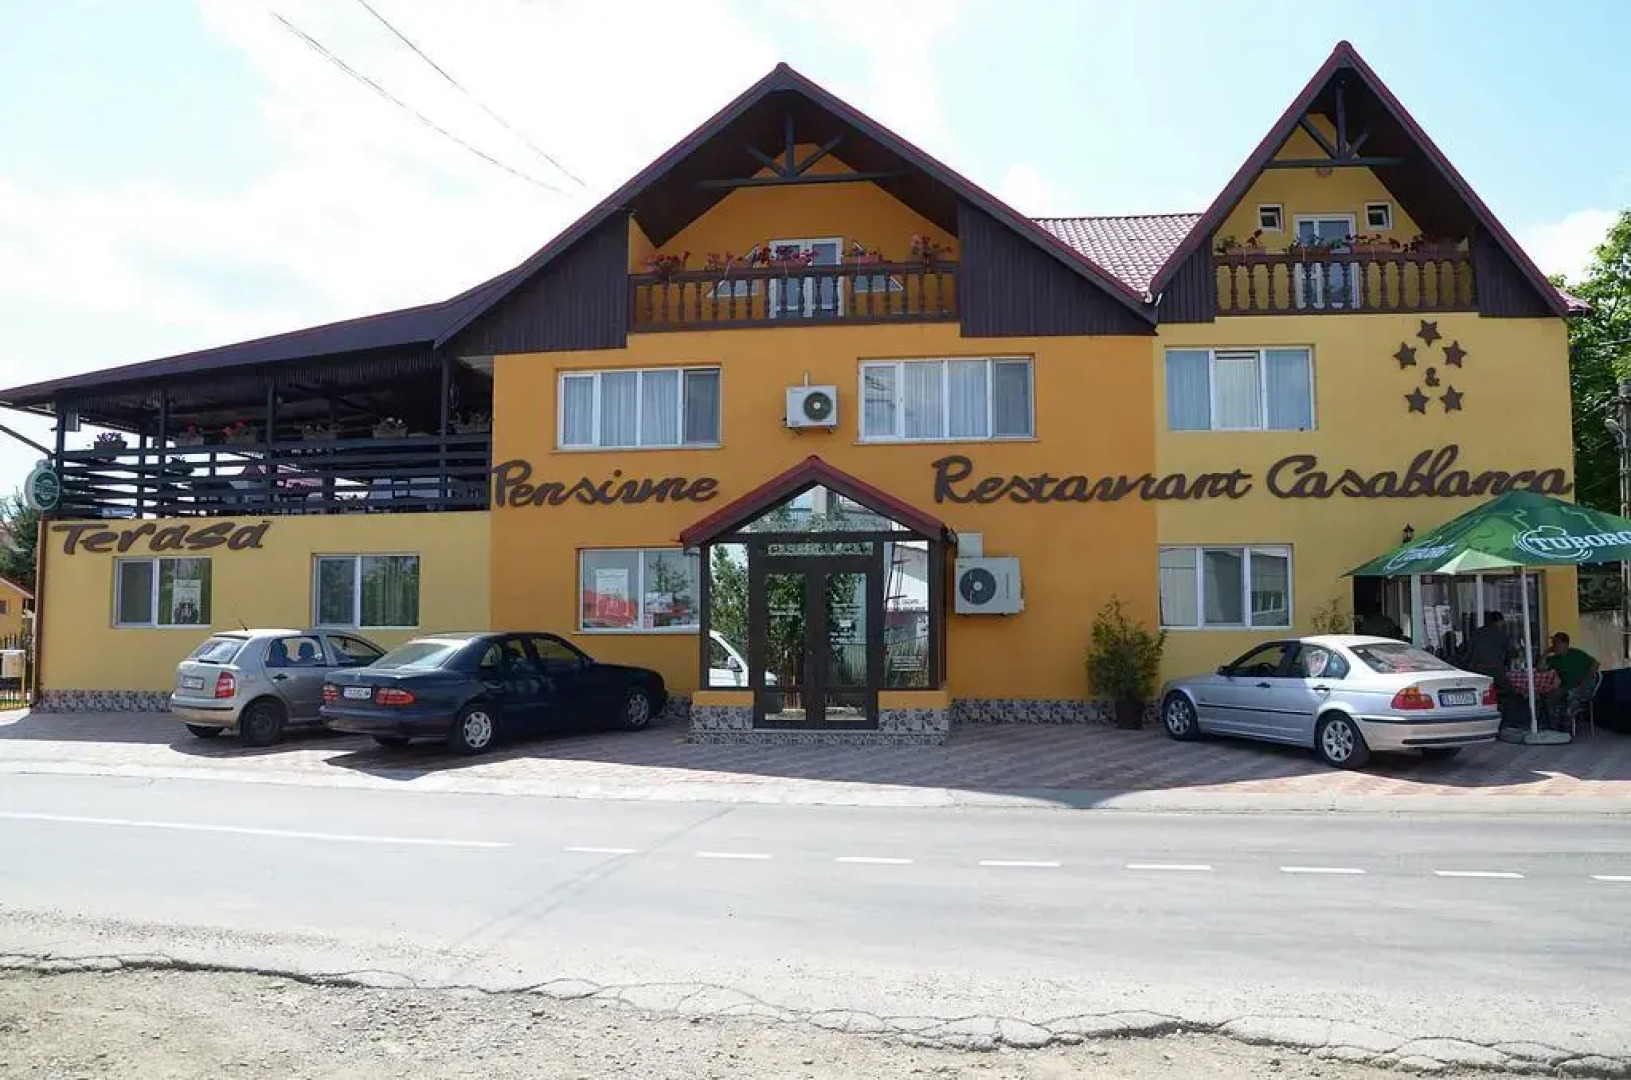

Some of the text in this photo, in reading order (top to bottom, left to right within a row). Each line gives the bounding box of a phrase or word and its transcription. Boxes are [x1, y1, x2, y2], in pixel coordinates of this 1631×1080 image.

[489, 443, 1574, 508] Pensiune Restaurant Casablanca
[51, 521, 270, 555] Terasa
